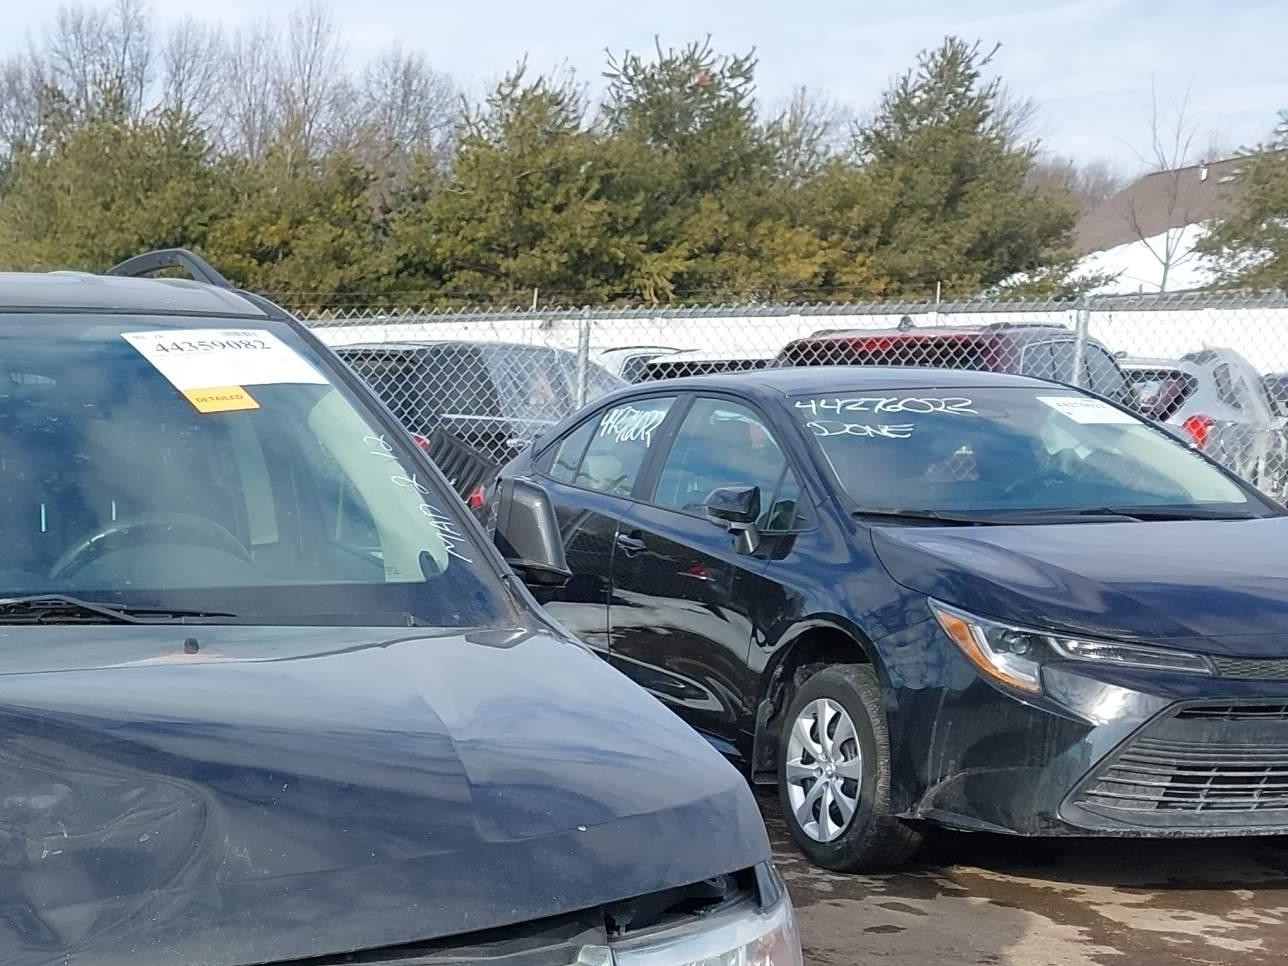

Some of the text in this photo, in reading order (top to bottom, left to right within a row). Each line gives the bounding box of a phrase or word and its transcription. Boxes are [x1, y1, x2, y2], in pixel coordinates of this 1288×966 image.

[155, 339, 272, 353] 44359082
[195, 394, 244, 404] DETAILED
[807, 421, 915, 438] DONE
